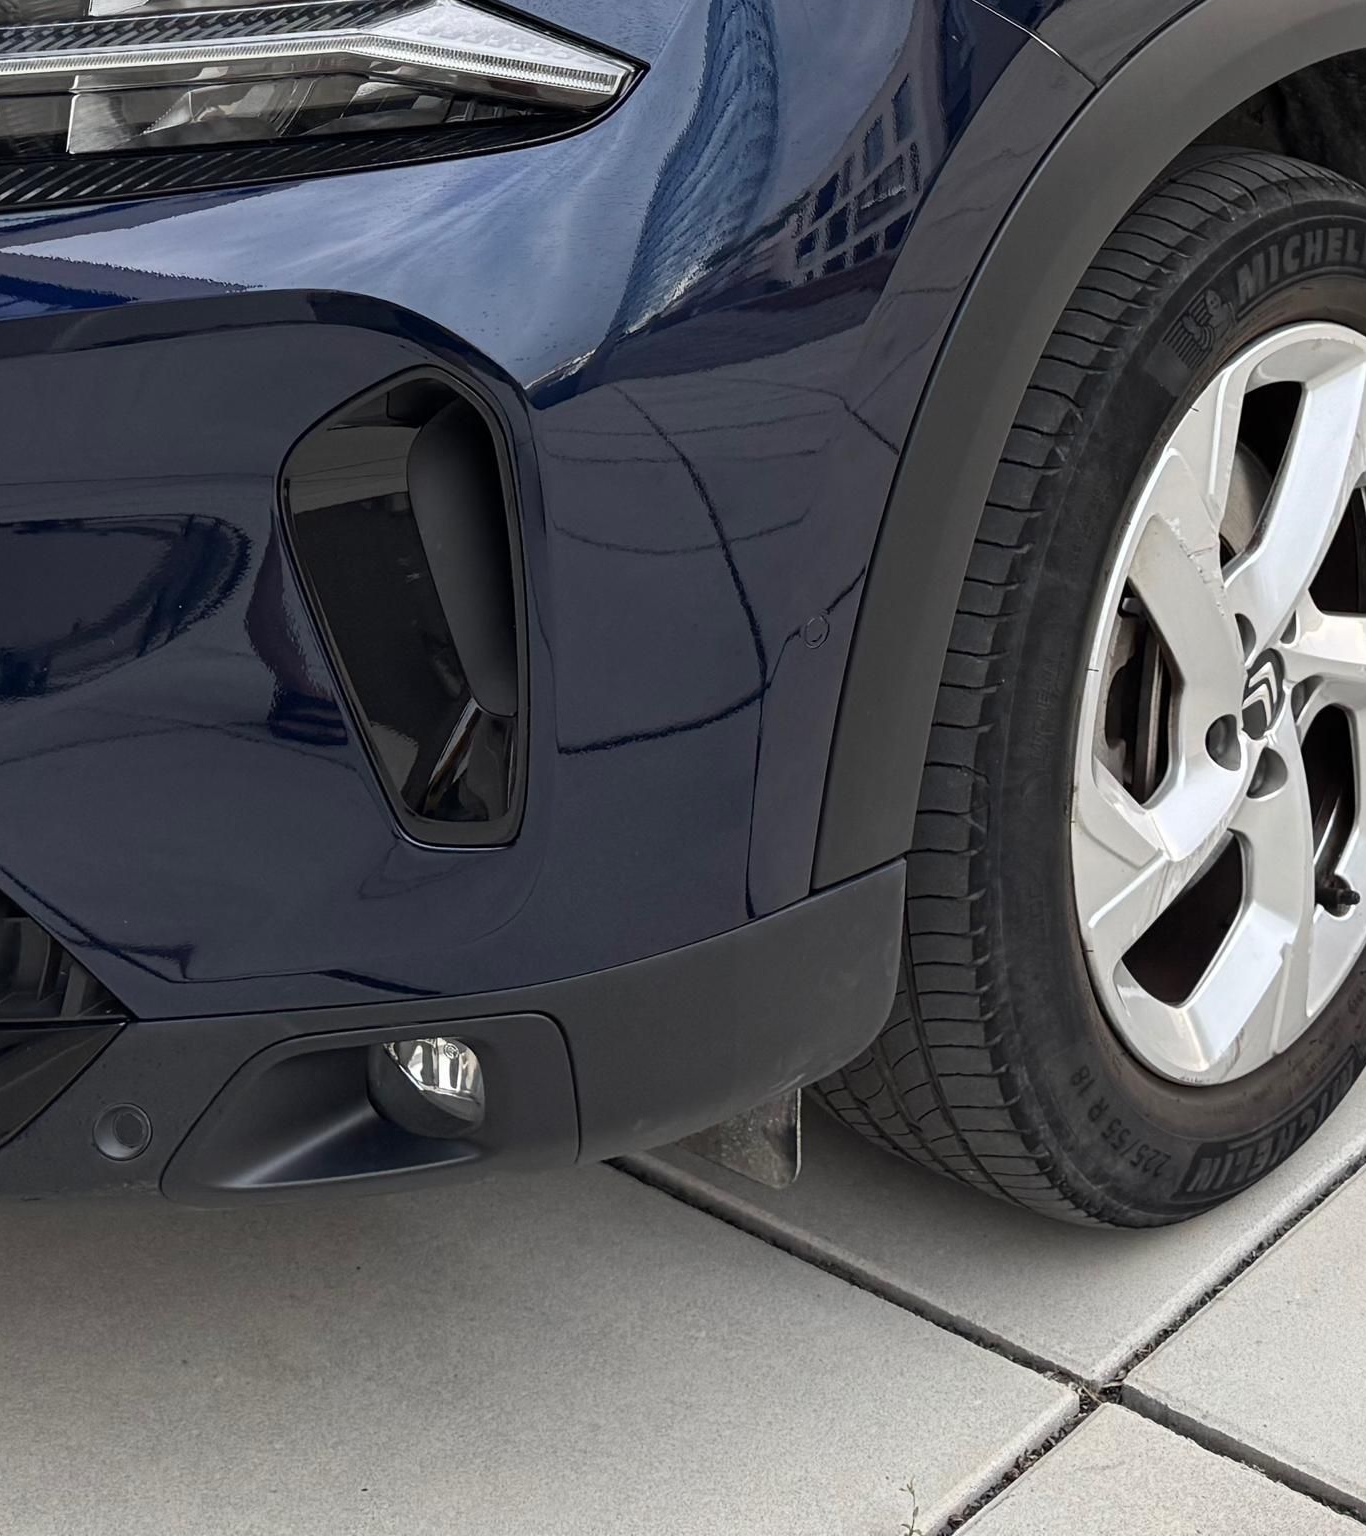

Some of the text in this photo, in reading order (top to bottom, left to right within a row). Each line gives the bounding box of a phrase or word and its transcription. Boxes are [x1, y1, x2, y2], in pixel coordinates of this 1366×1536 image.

[1070, 1065, 1172, 1178] 225/55 R 18
